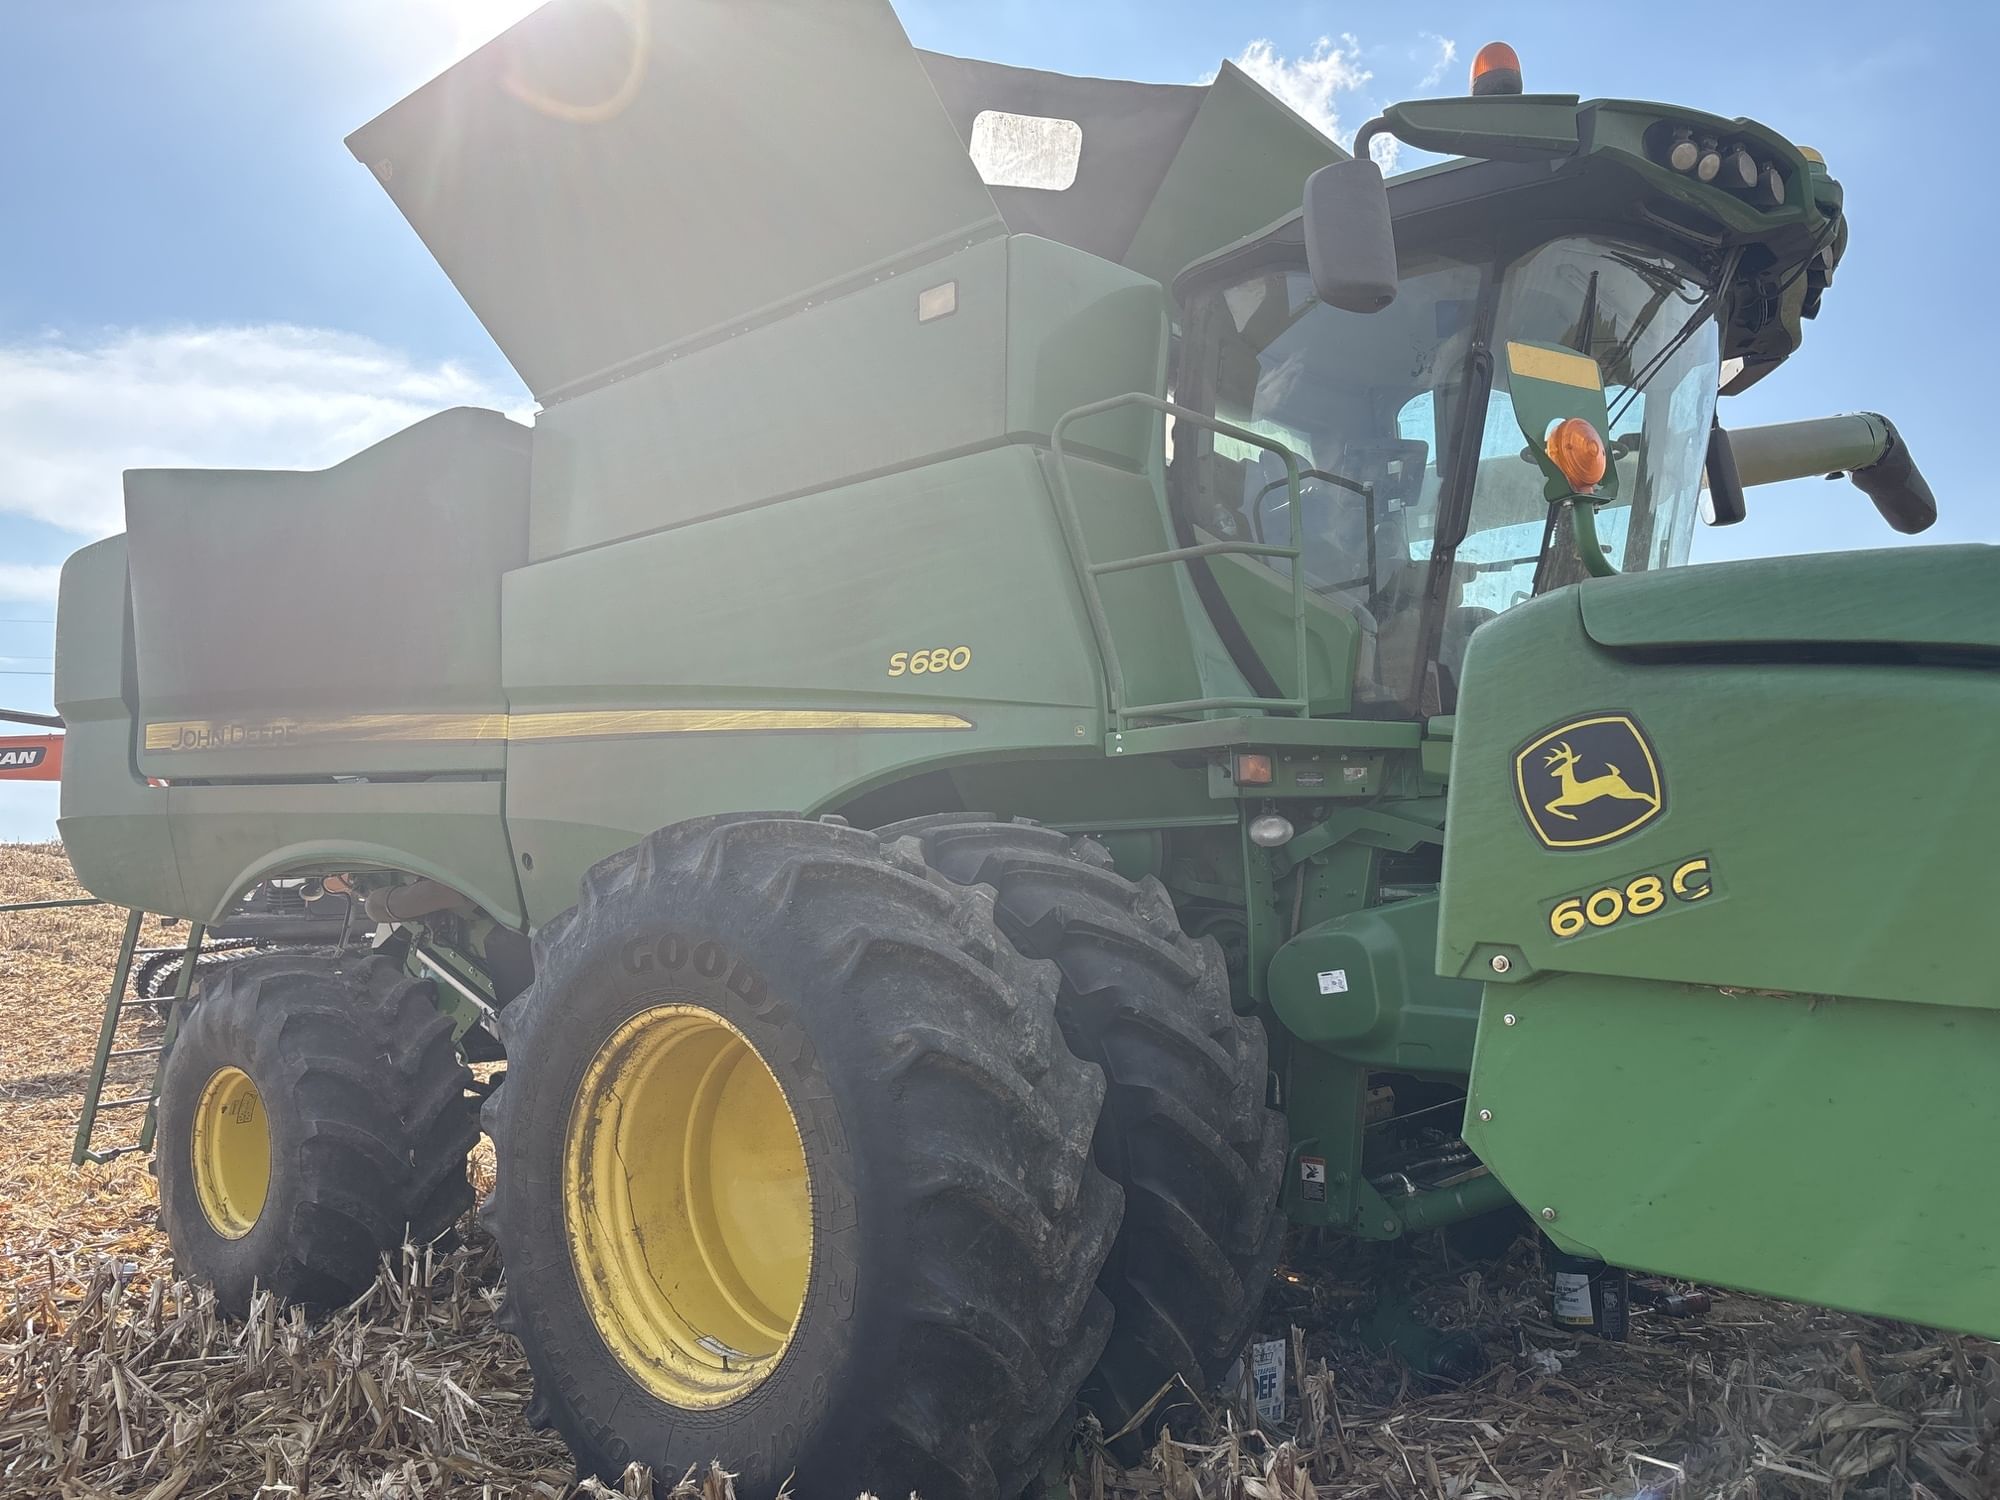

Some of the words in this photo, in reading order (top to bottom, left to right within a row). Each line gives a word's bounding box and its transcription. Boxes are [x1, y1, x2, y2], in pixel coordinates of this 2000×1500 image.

[887, 645, 972, 678] S680
[171, 727, 225, 749] JOHN
[230, 724, 298, 745] DEERE
[0, 751, 37, 765] AN
